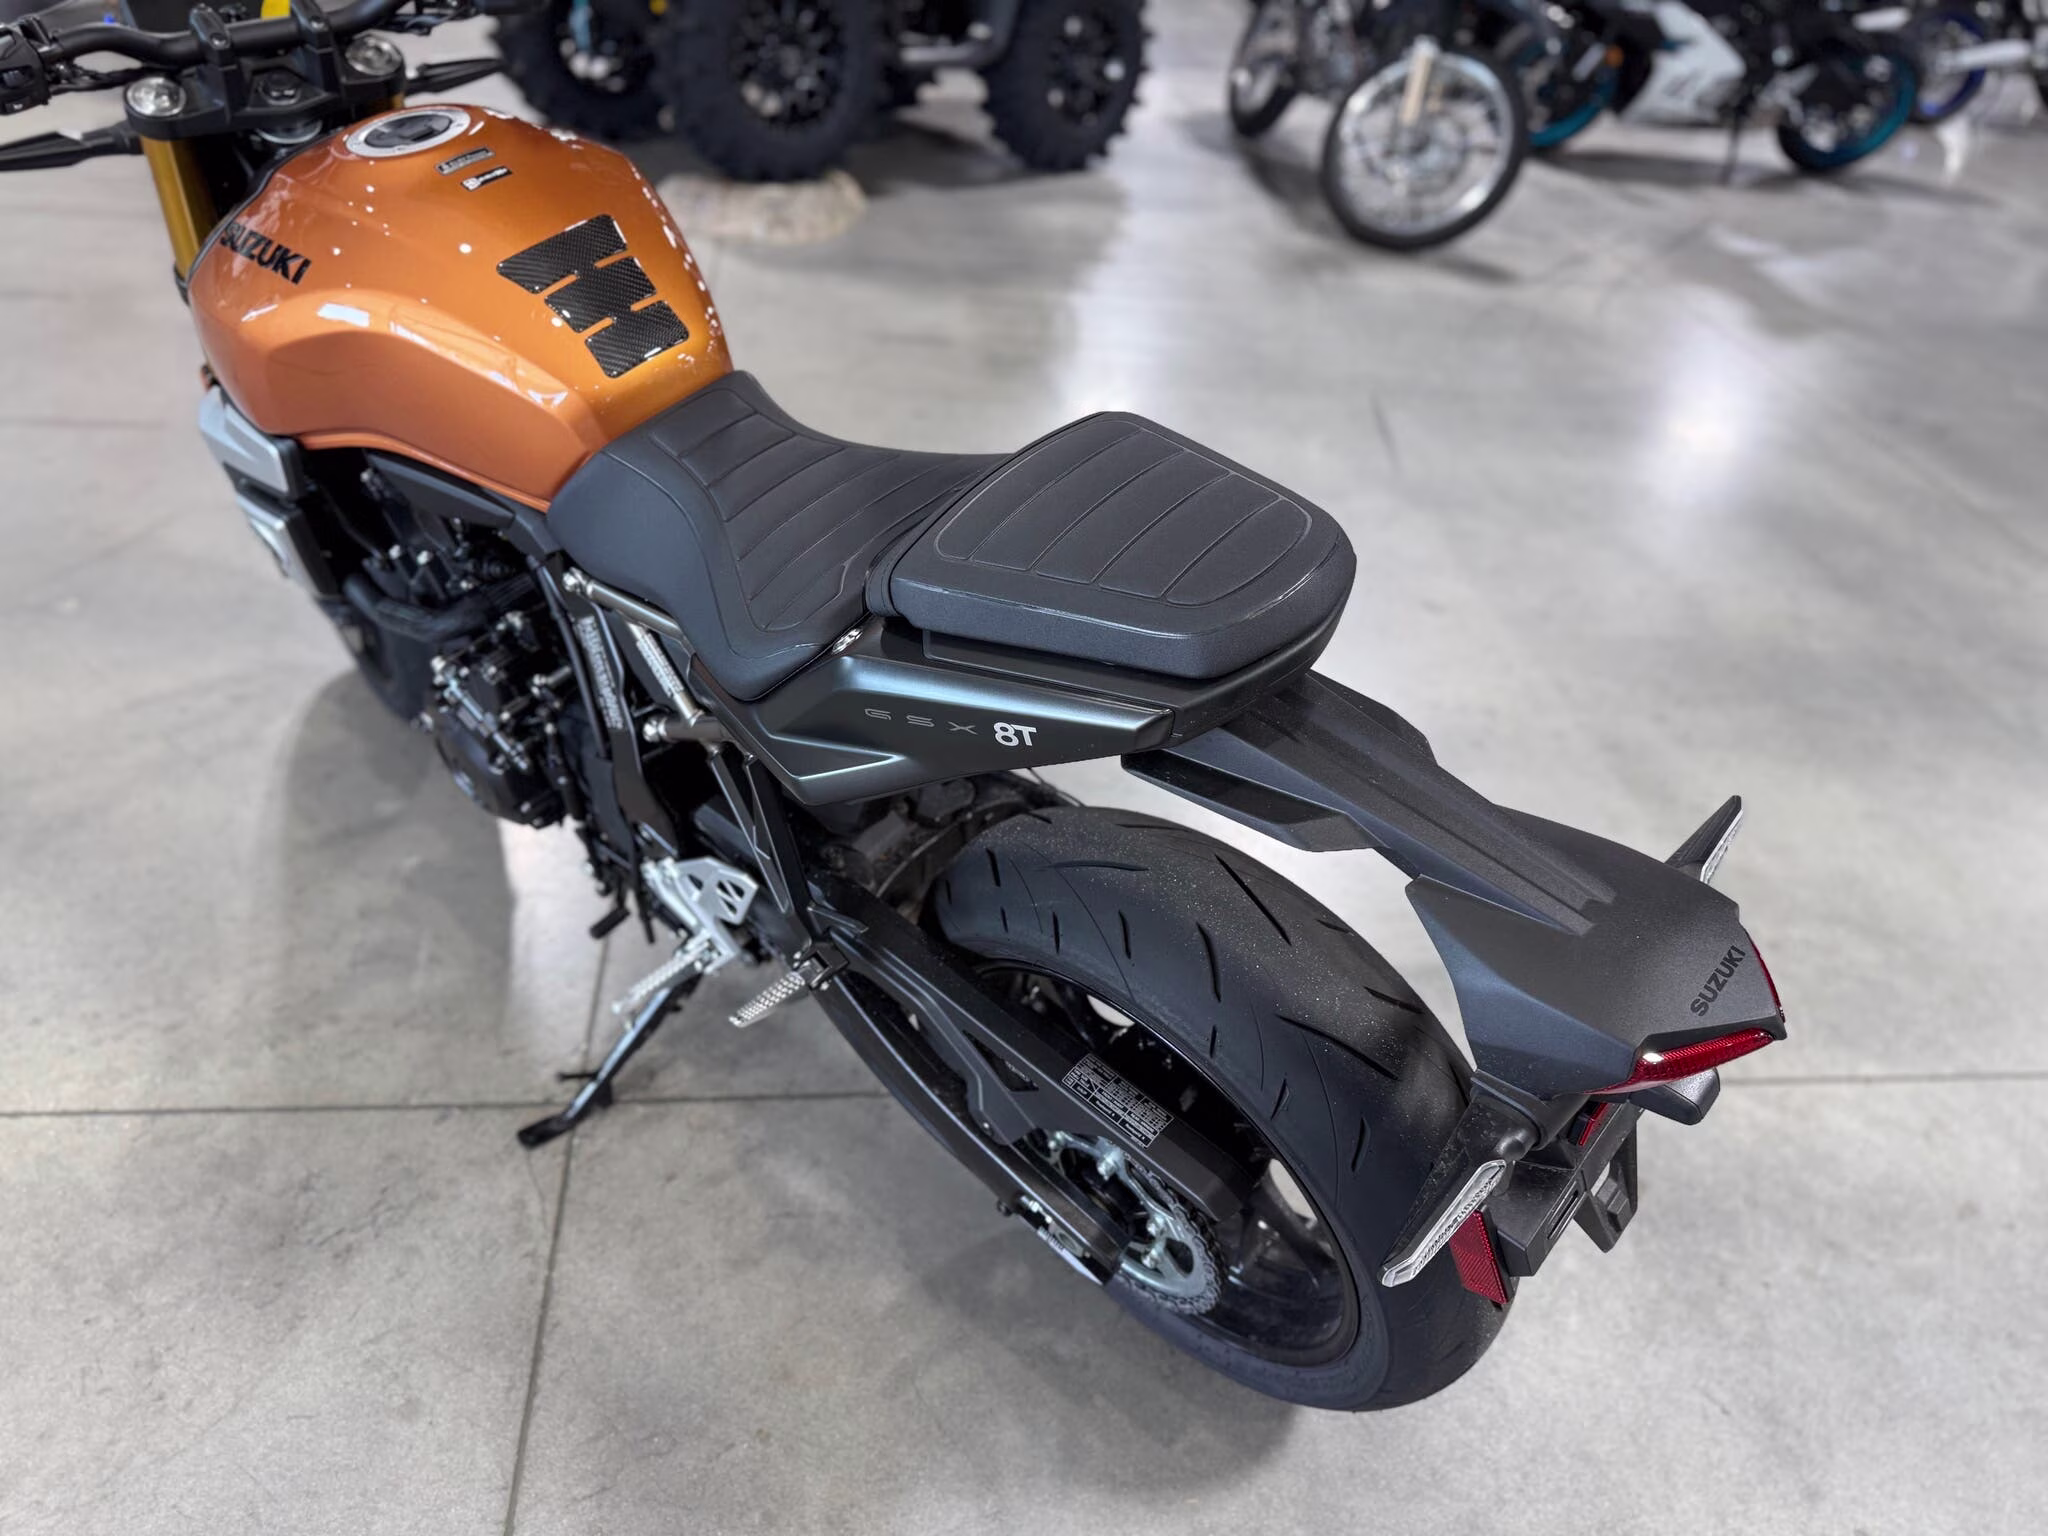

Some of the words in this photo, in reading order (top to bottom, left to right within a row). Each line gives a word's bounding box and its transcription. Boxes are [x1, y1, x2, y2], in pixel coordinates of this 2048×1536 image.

[220, 222, 312, 285] SUZUKI
[864, 708, 979, 736] GSX
[993, 721, 1038, 747] 8T
[1690, 945, 1746, 1017] SUZUKI
